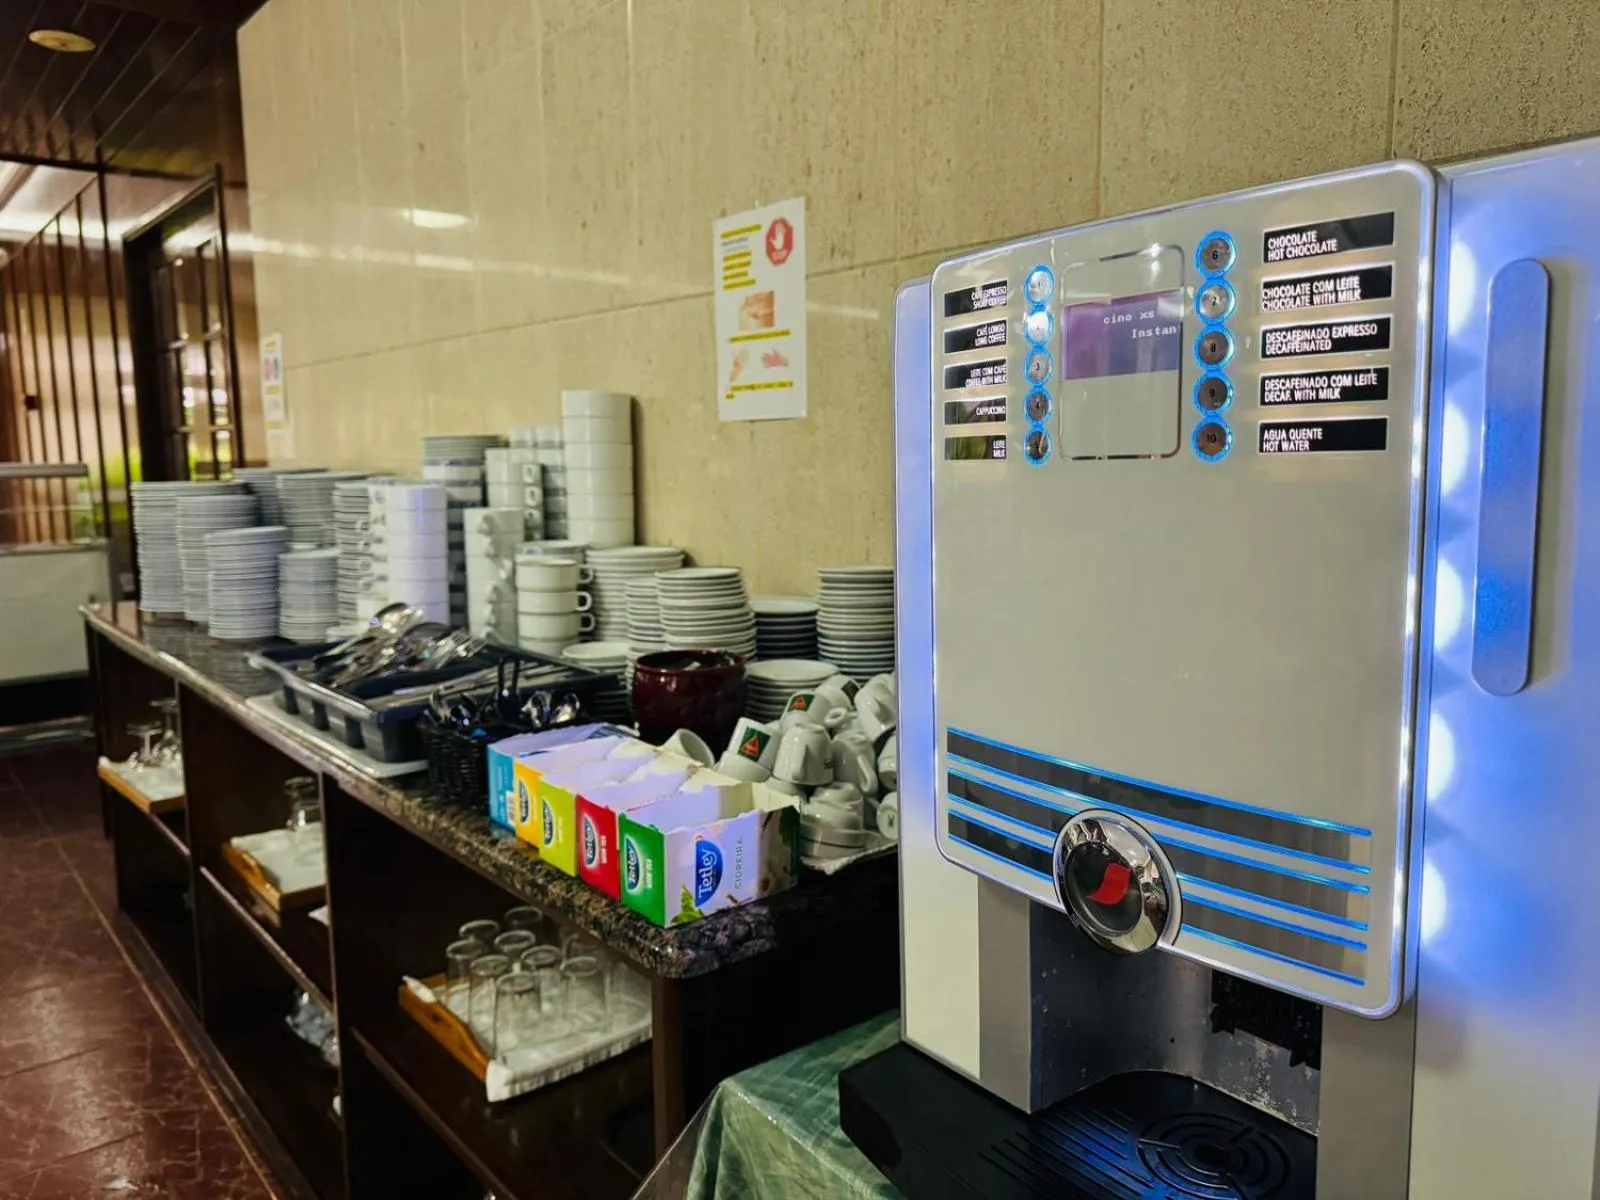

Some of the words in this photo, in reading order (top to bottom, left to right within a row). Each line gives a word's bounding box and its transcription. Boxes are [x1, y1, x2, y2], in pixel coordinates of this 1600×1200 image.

[1268, 231, 1317, 250] CHOCOLATE
[1268, 249, 1284, 261] HOT
[1286, 239, 1337, 259] CHOCOLATE
[1212, 250, 1219, 260] 6
[1262, 283, 1311, 299] CHOCOLATE
[1312, 280, 1334, 293] COM
[1336, 275, 1360, 290] LEITE
[1261, 296, 1310, 311] CHOCOLATE
[1312, 292, 1335, 305] WITH
[1337, 288, 1361, 303] MILK
[1265, 327, 1330, 344] DESCAFEINADO
[1331, 323, 1378, 338] EXPRESSO
[1210, 343, 1217, 353] 8
[1265, 340, 1332, 356] DECAFFEINATED
[1264, 376, 1328, 391] DESCAFEINADO
[1330, 374, 1352, 388] COM
[1354, 372, 1378, 386] LEITE
[1264, 390, 1292, 402] DECAF.
[1294, 389, 1317, 401] WITH
[1318, 387, 1341, 400] MILK
[1263, 429, 1287, 441] AGUA
[1289, 428, 1323, 440] QUENTE
[1263, 441, 1280, 452] HOT
[1281, 440, 1310, 451] WATER
[698, 848, 718, 898] Tetley
